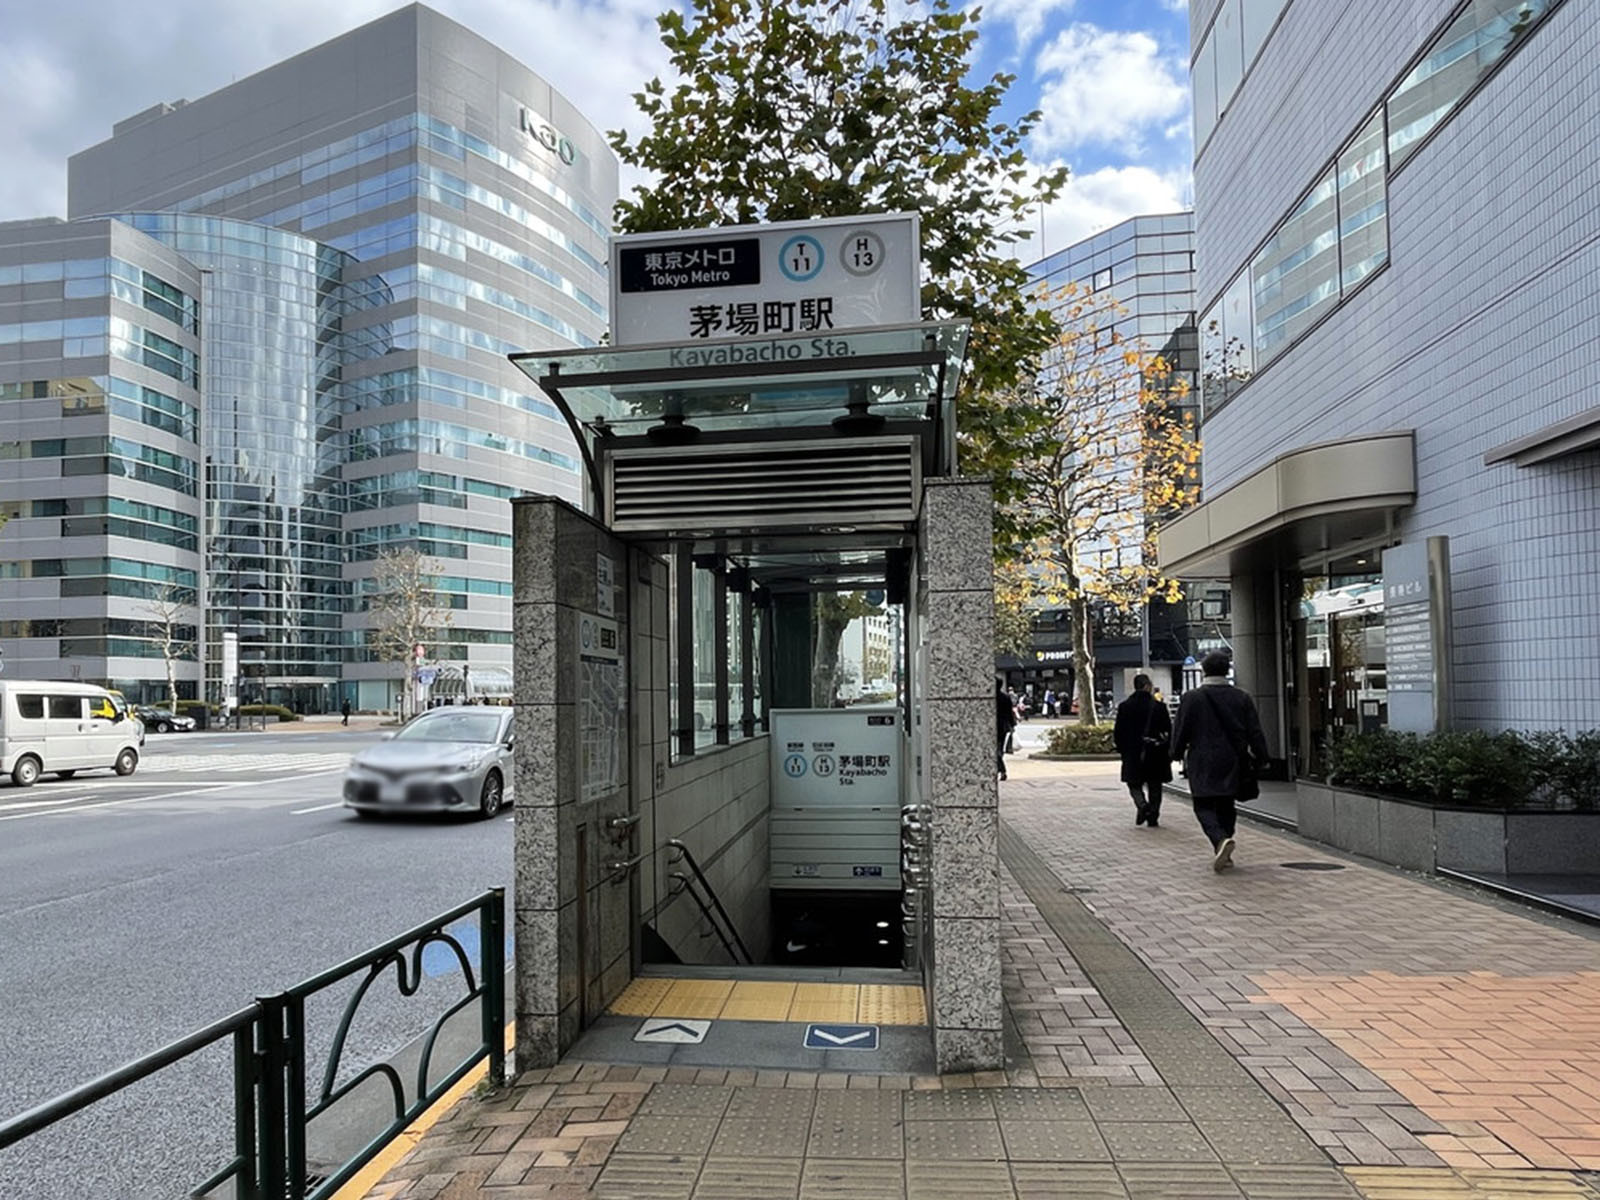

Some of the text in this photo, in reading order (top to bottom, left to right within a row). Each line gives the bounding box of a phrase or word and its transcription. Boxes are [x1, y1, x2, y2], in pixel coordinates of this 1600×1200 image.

[797, 243, 806, 256] T
[856, 238, 868, 251] H
[644, 247, 736, 271] 東京メトロ
[792, 257, 811, 273] 11
[853, 252, 874, 267] 13
[650, 269, 730, 288] Tokyo Metro
[689, 297, 834, 338] 茅場町駅
[670, 338, 857, 366] Kayabacho Sta.
[791, 765, 801, 773] 11
[819, 765, 830, 773] 13
[839, 755, 891, 769] 茅場町駅
[839, 769, 888, 778] Kayabacho
